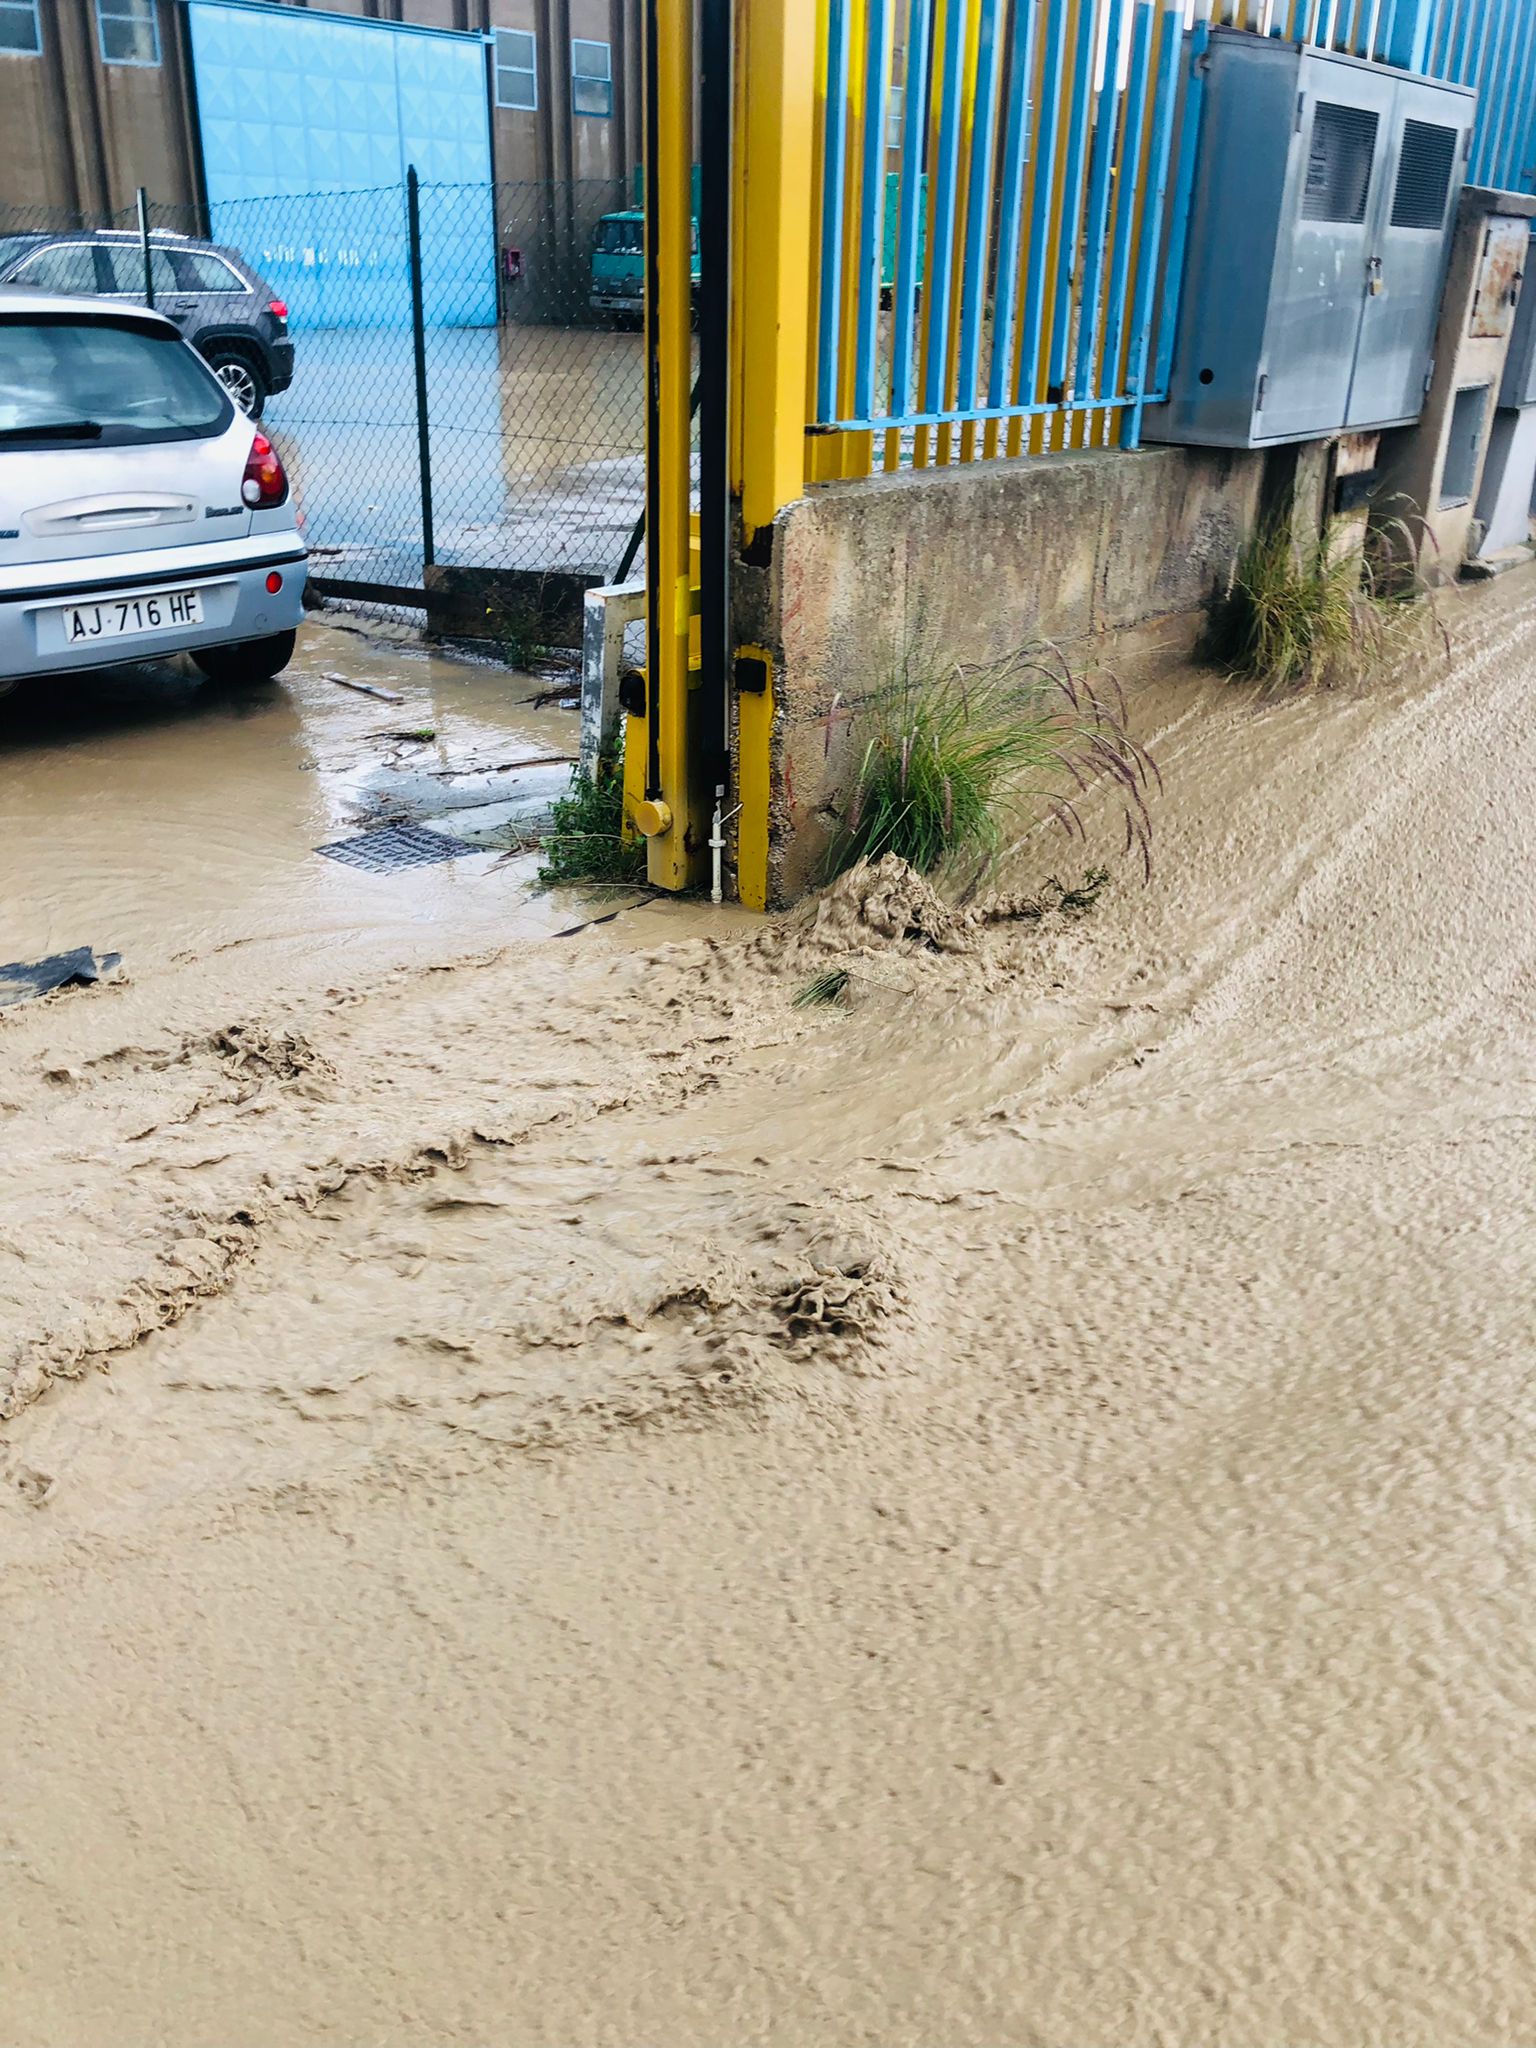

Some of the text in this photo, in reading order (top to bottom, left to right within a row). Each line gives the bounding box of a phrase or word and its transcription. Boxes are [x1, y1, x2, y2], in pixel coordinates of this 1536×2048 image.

[71, 594, 196, 640] AJ 716 HF
